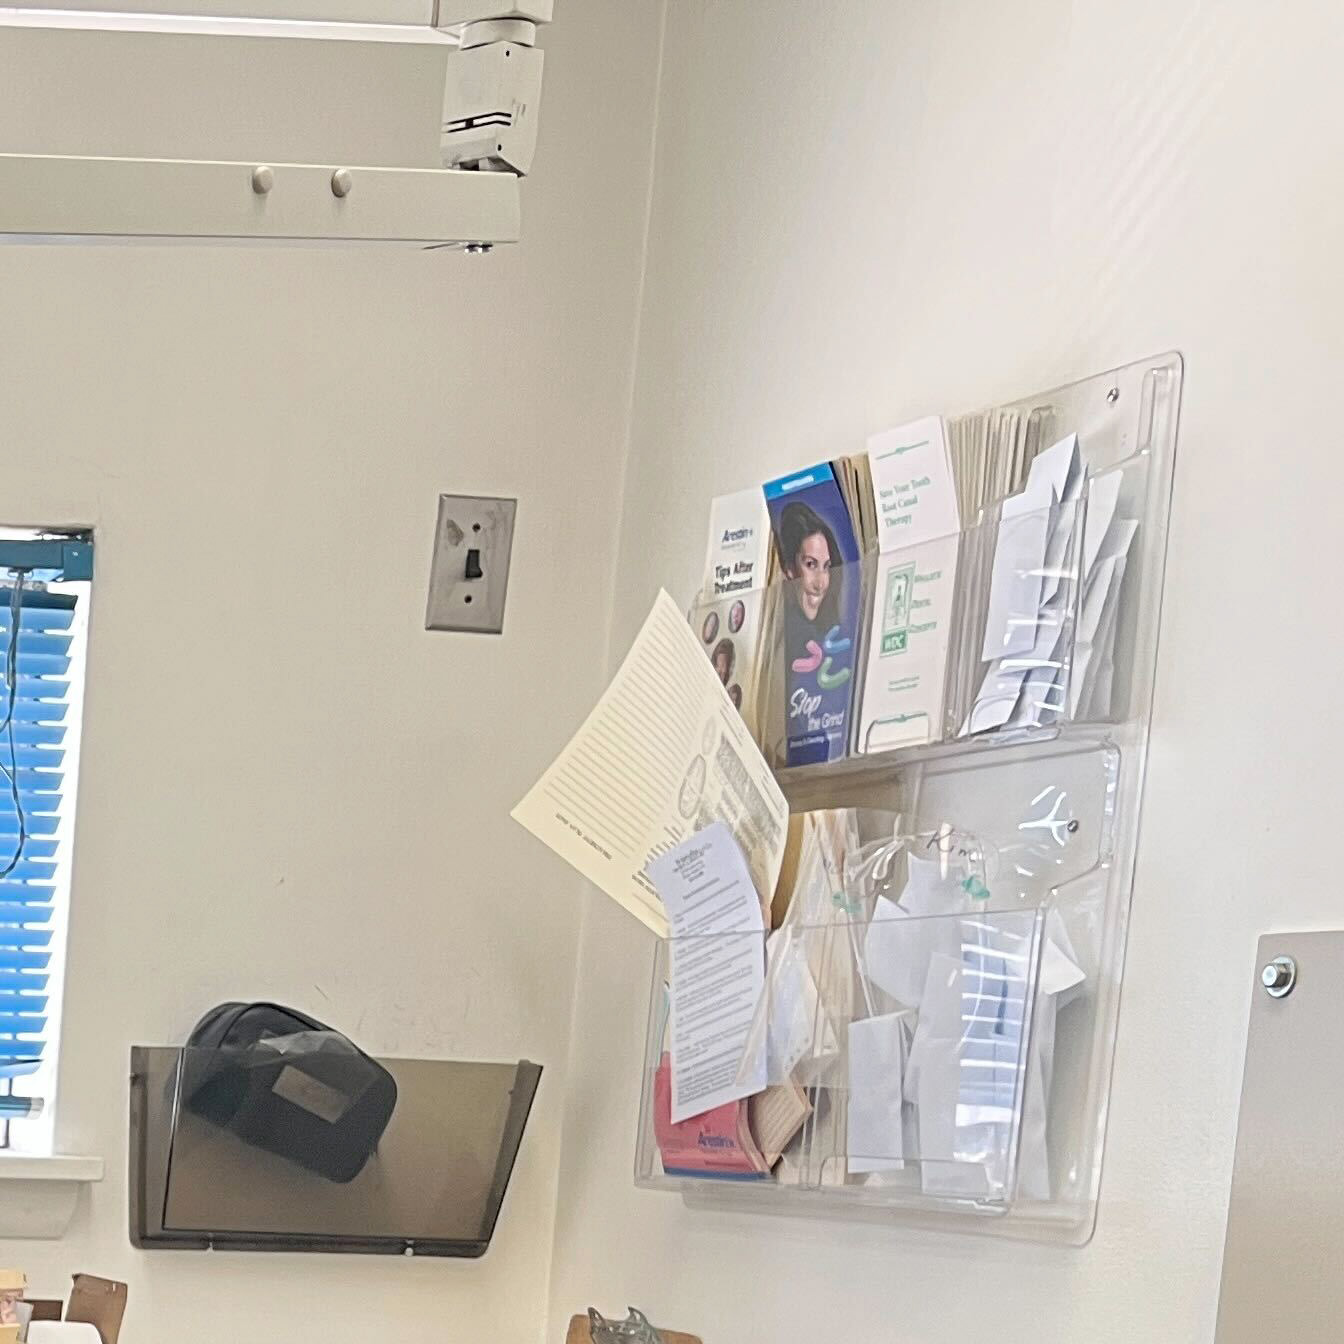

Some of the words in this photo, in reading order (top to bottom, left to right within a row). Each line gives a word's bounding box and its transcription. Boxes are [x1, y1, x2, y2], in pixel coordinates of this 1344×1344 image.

[734, 560, 754, 575] After
[714, 576, 752, 595] Treatment
[790, 687, 822, 718] Stop
